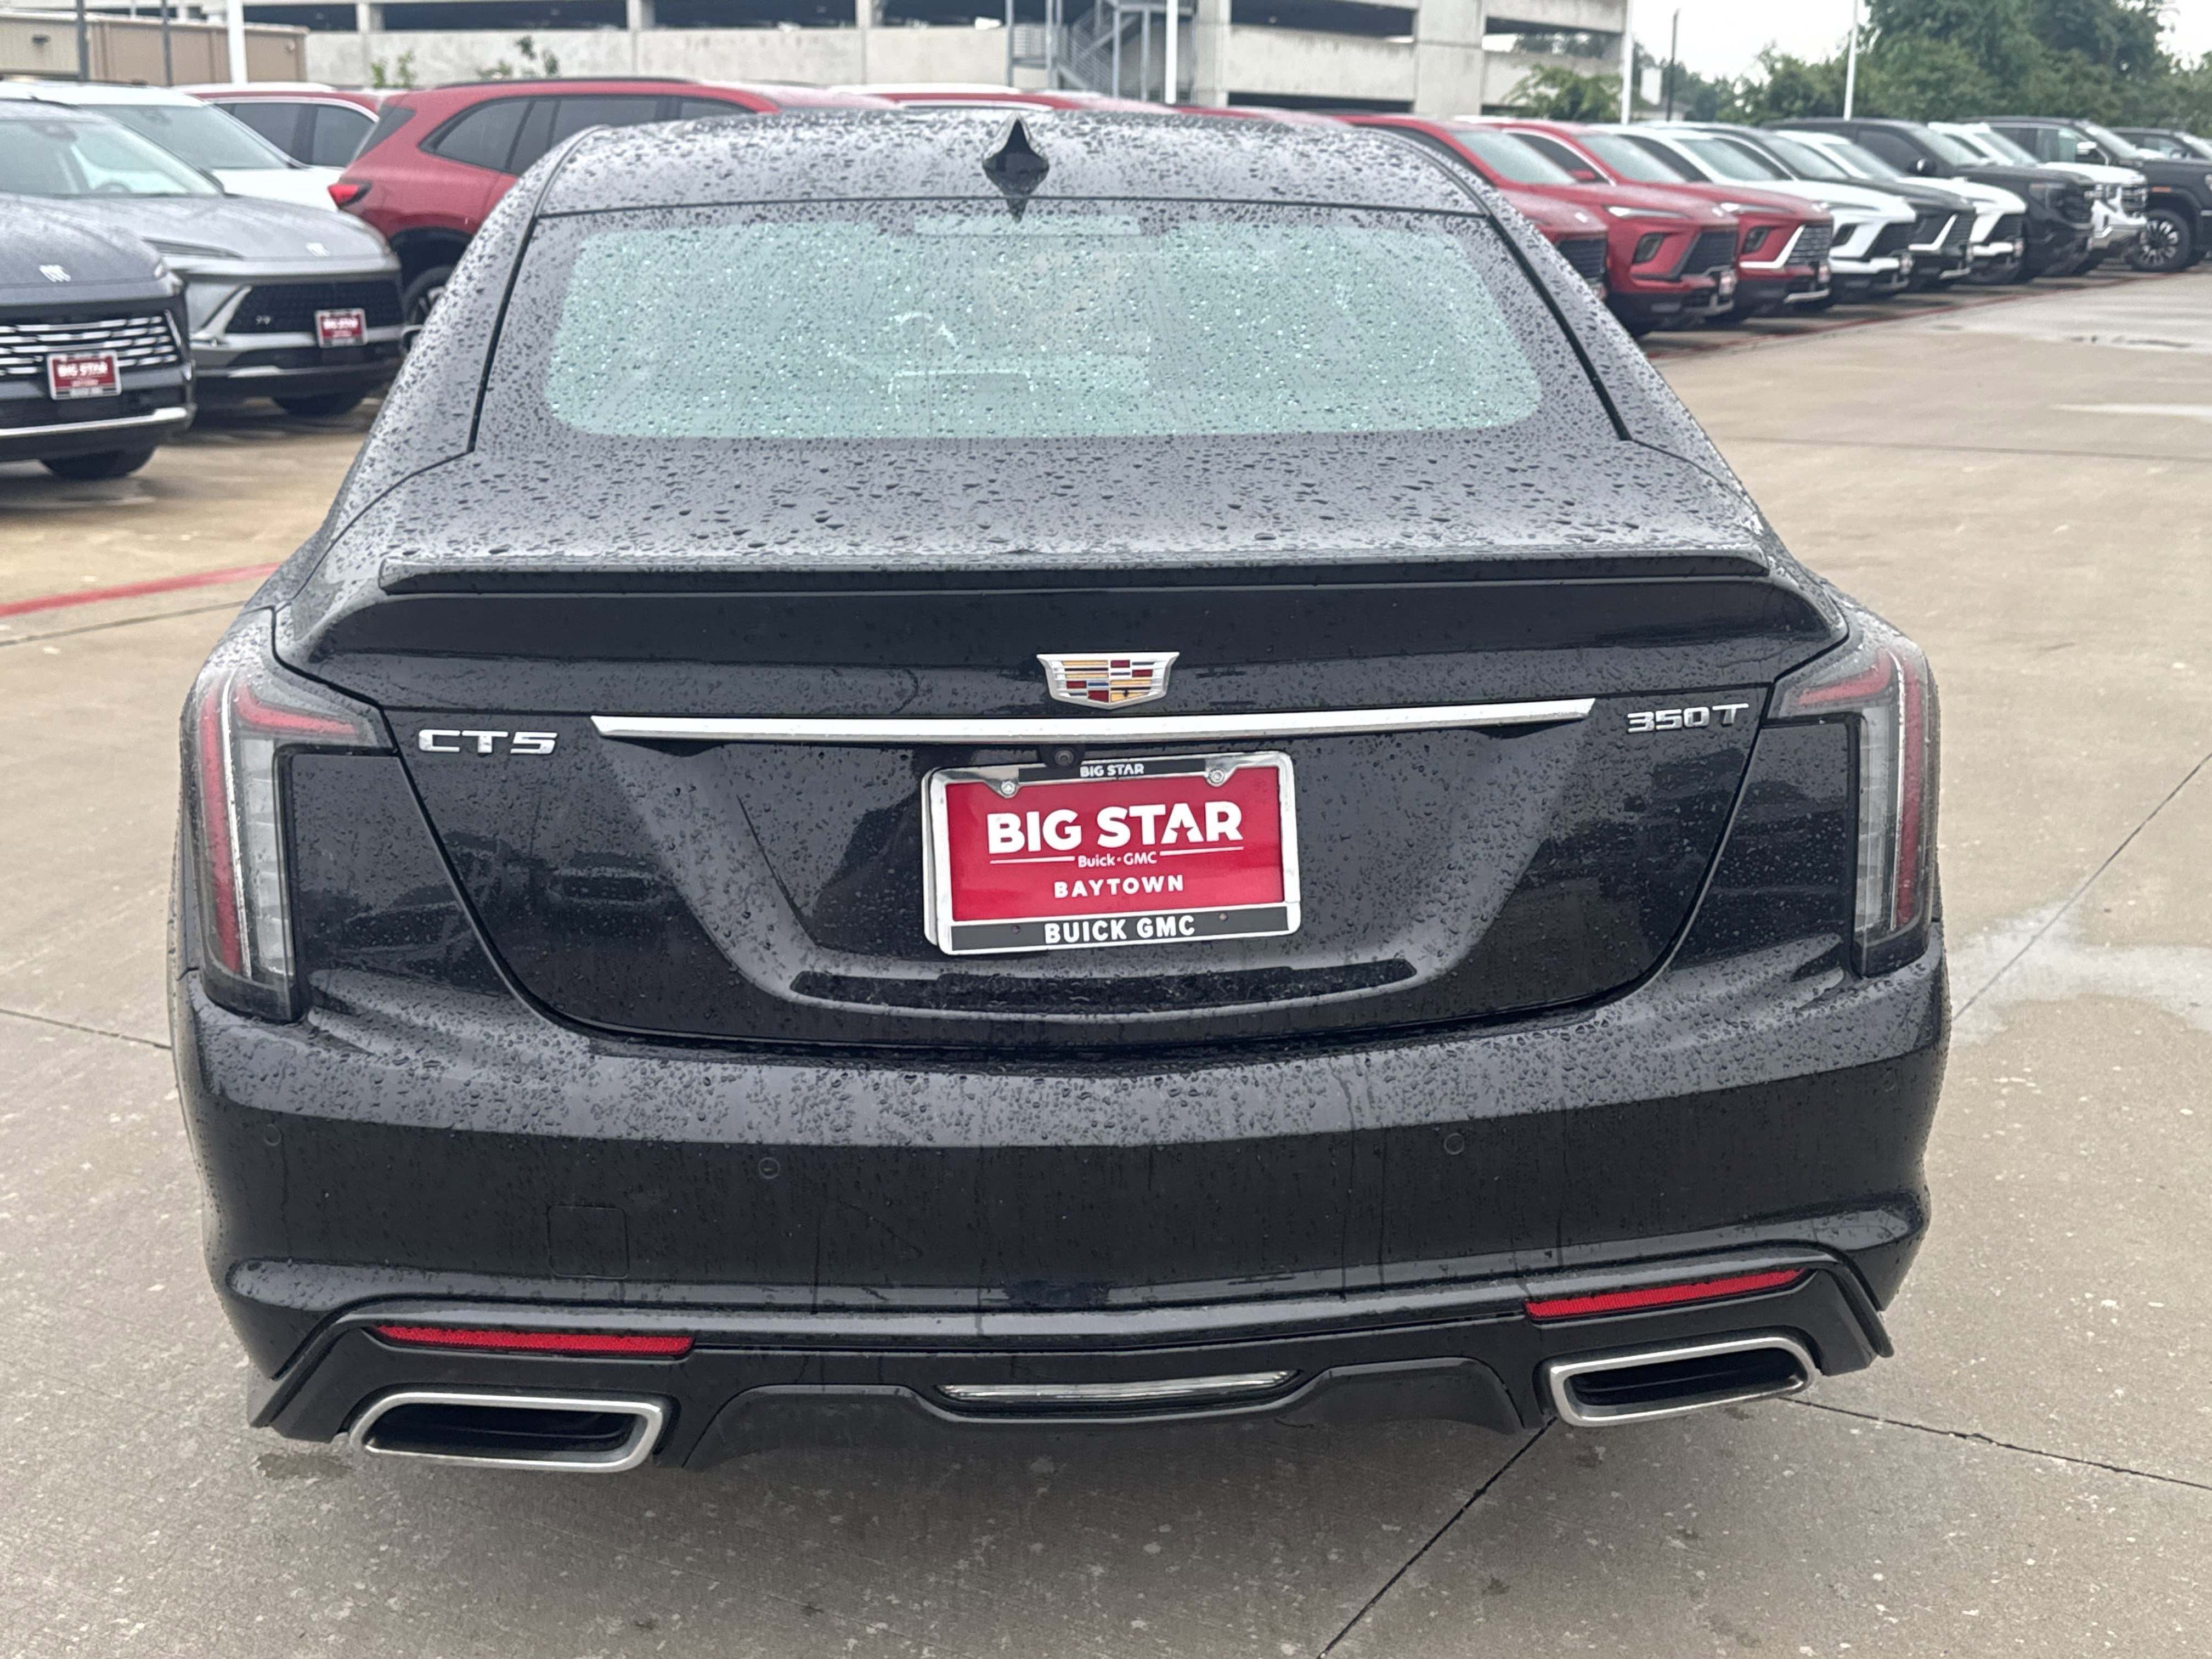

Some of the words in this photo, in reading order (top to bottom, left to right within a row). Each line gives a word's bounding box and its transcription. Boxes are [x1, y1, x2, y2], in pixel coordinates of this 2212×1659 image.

[1080, 765, 1104, 777] BIG
[1107, 763, 1144, 776] STAR
[988, 809, 1082, 854] BIG
[1097, 802, 1243, 848] STAR
[1054, 874, 1183, 899] BAYTOWN
[1045, 919, 1127, 943] BUICK
[1137, 916, 1195, 937] GMC
